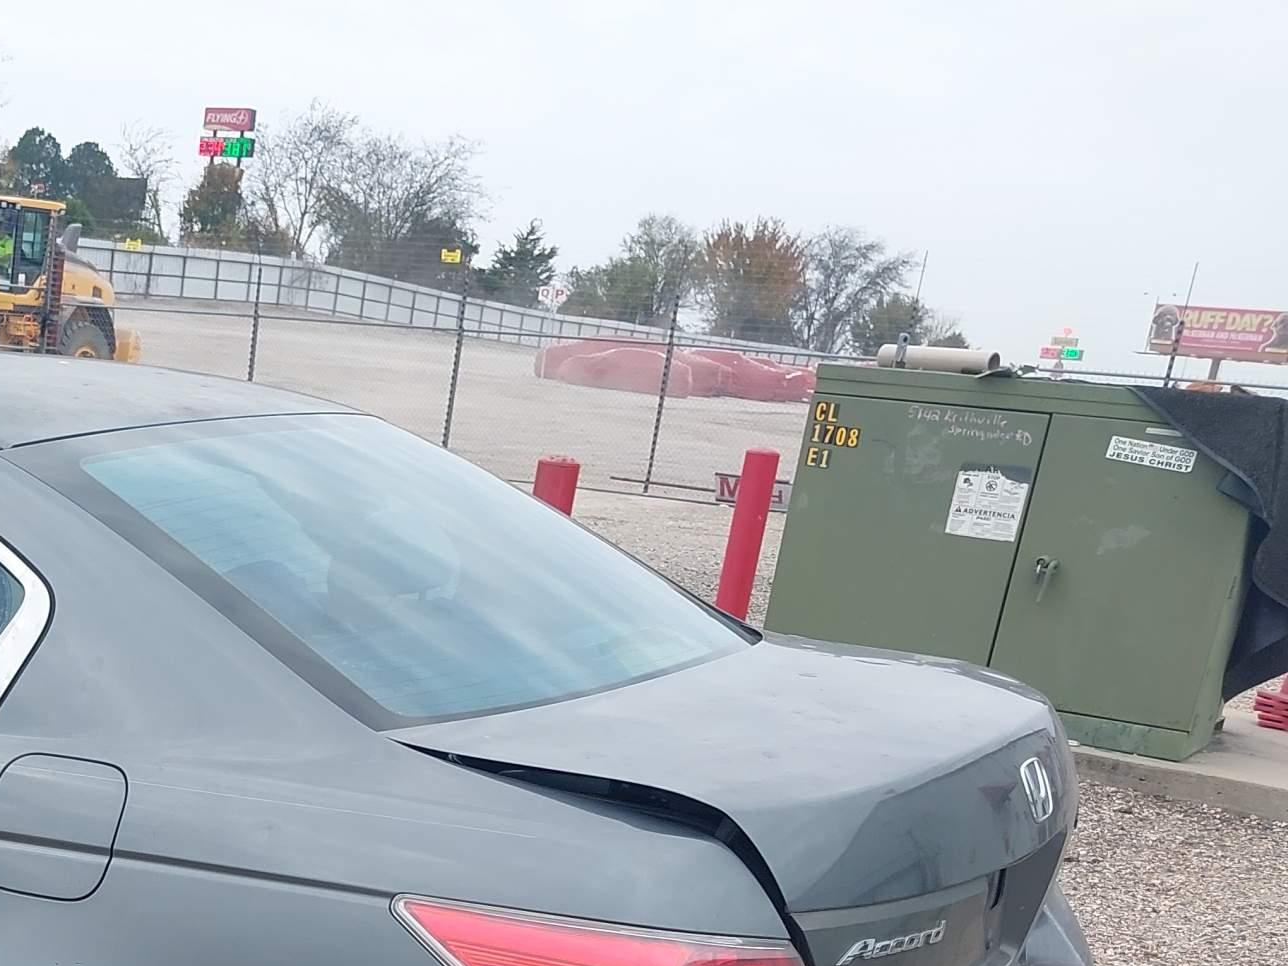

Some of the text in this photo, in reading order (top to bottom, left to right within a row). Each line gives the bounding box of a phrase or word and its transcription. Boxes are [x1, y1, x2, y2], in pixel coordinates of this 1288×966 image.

[1183, 310, 1273, 332] RUFF DAY?
[815, 402, 838, 422] CL
[811, 424, 859, 447] 1708
[806, 447, 829, 468] E1
[1113, 444, 1127, 452] One
[1151, 451, 1165, 460] Son
[1174, 456, 1192, 465] GOD
[1114, 437, 1127, 445] One
[1159, 446, 1178, 455] Under
[1179, 450, 1195, 458] GOD
[1109, 451, 1191, 471] JESUS CHRIST
[963, 508, 1016, 519] ADVERTENCIA
[835, 920, 947, 966] Accord
